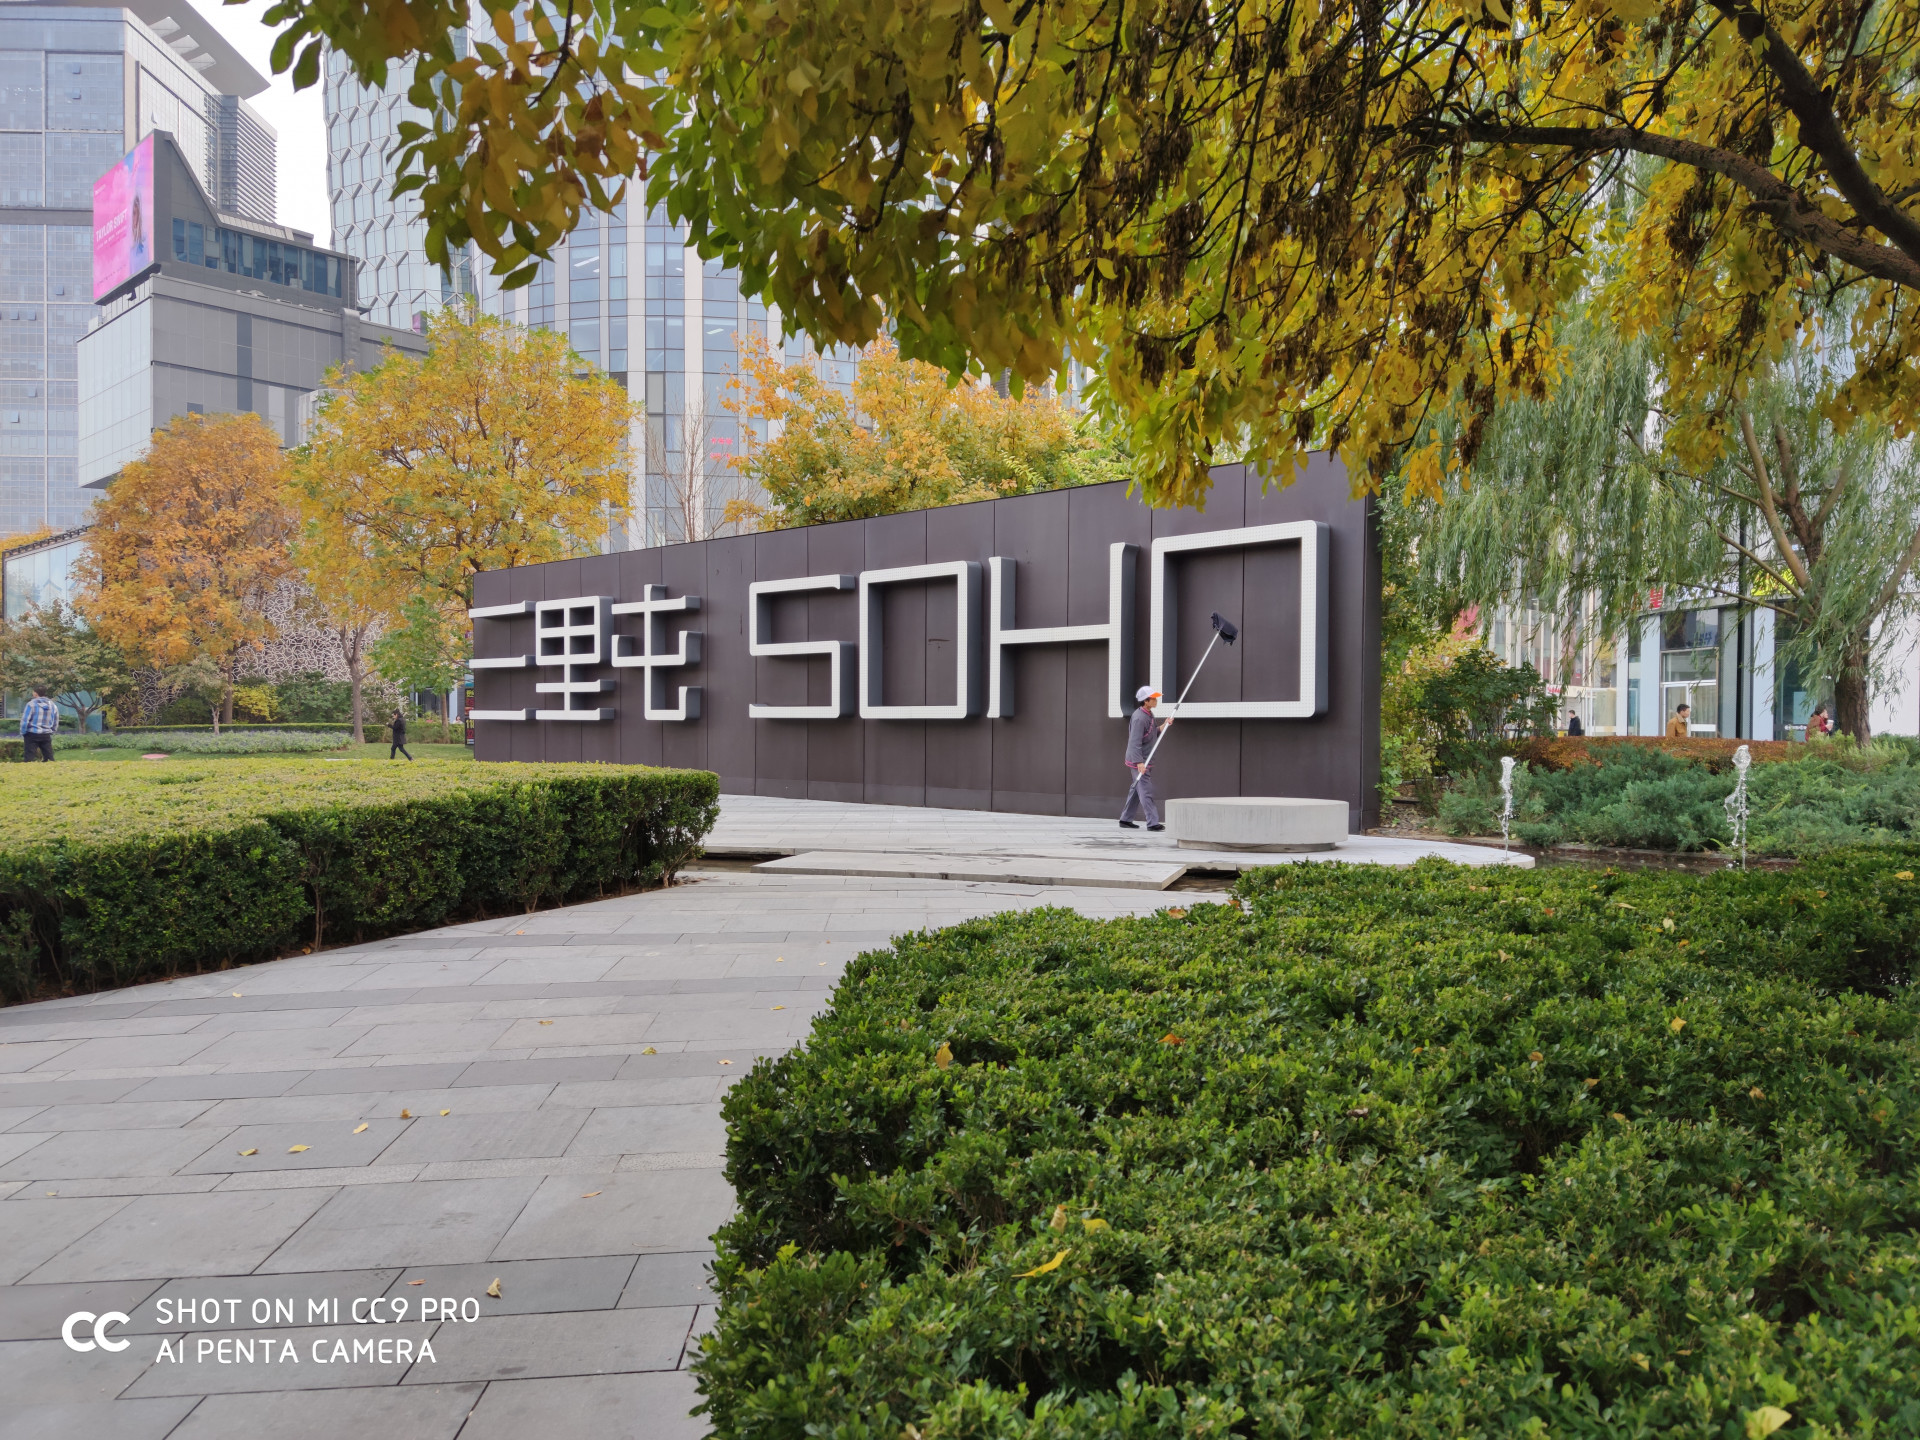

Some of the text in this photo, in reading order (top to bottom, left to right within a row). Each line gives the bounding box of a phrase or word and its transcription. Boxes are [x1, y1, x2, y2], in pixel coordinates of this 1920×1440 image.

[96, 220, 114, 241] TAYLOR
[113, 208, 128, 228] SWIFT
[468, 520, 1329, 721] 三里屯 SOHO
